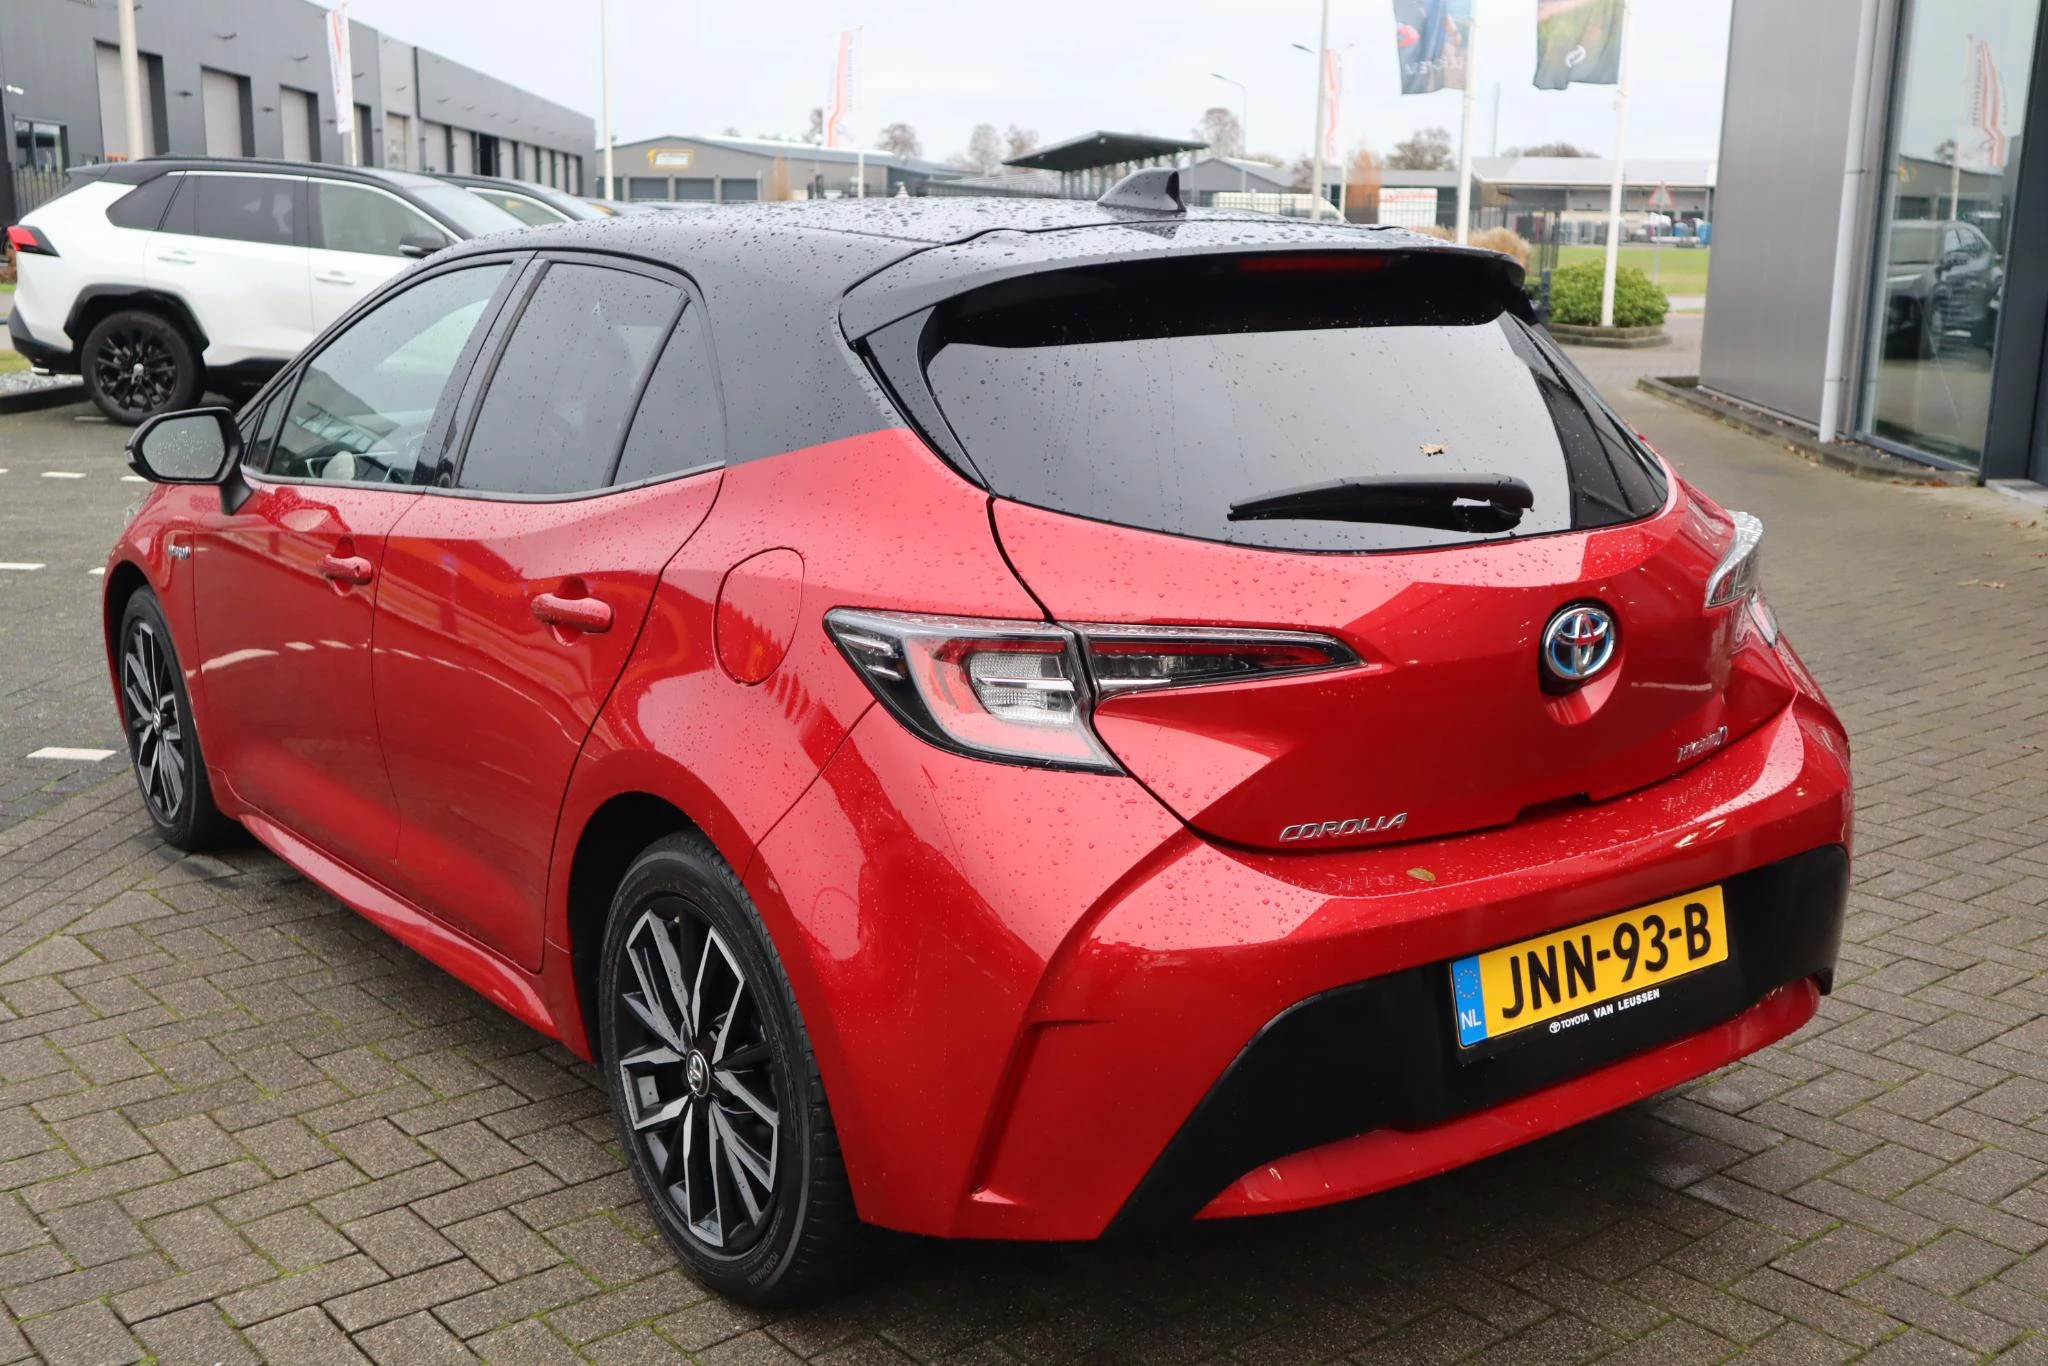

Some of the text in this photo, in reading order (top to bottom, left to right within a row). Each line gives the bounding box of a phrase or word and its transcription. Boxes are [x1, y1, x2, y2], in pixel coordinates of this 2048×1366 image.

[1279, 812, 1407, 842] COROLLA
[1502, 903, 1711, 1018] JNN-93-B
[1461, 1008, 1482, 1030] NL
[1561, 988, 1660, 1029] TOYOTA VAN LEUSSEN
